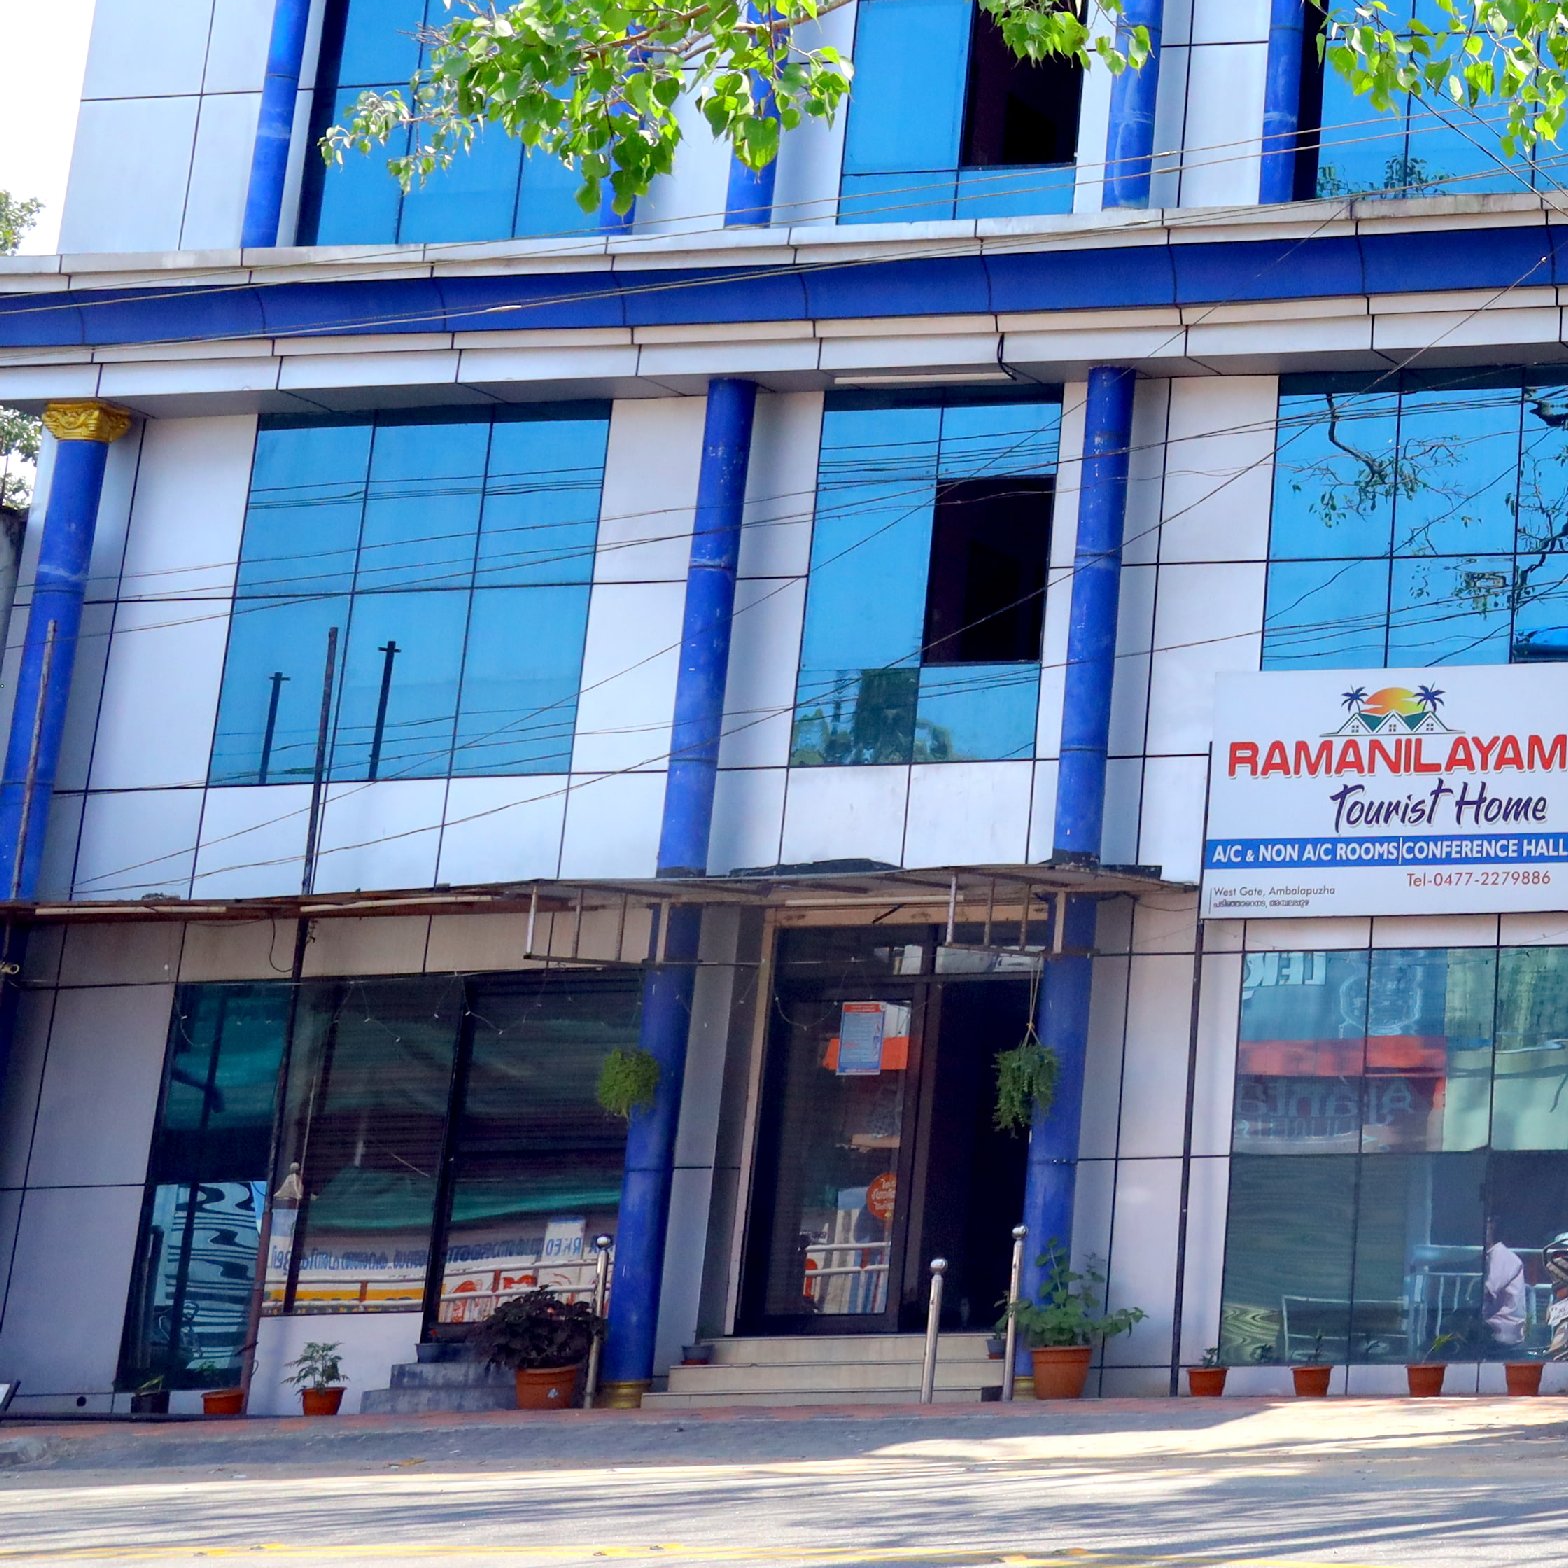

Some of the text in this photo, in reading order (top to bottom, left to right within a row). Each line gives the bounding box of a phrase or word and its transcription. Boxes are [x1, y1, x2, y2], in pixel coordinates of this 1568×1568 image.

[1228, 734, 1568, 778] RAMANILAYAM
[1329, 777, 1548, 834] Tourist Home
[1212, 838, 1568, 863] A/C & NON A/C ROOMS CONFERENCE HALL
[1406, 870, 1551, 887] Tel-0477-2279886
[1213, 885, 1336, 898] West Gate, Ambalapuzha
